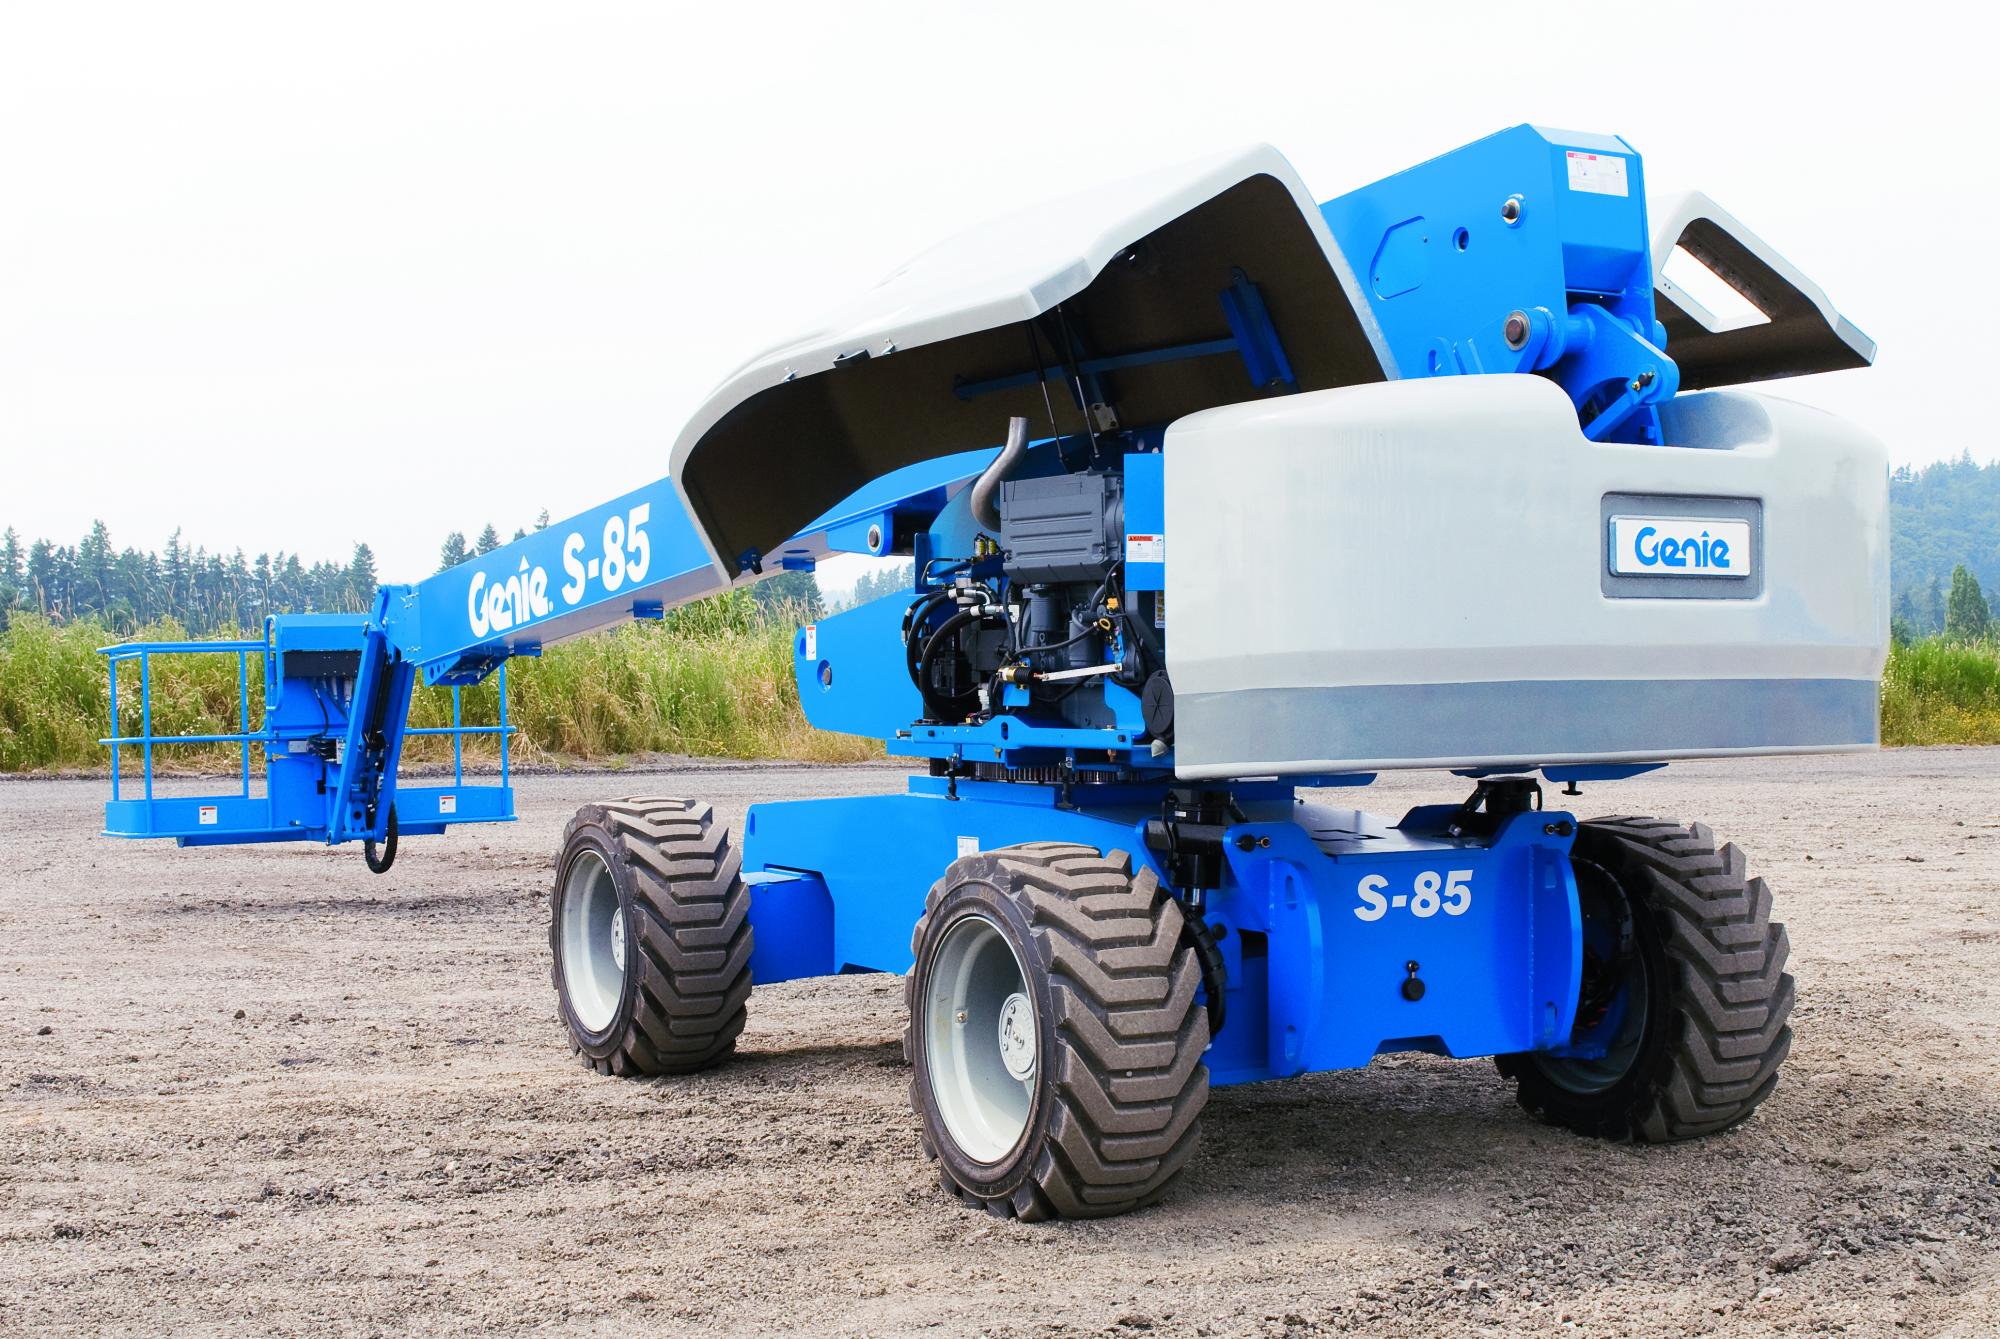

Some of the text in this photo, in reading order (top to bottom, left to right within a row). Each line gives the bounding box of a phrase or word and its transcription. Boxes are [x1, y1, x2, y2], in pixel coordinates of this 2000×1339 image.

[468, 503, 651, 638] Genie S-85
[1634, 526, 1731, 569] Genie
[1353, 869, 1474, 922] S-85
